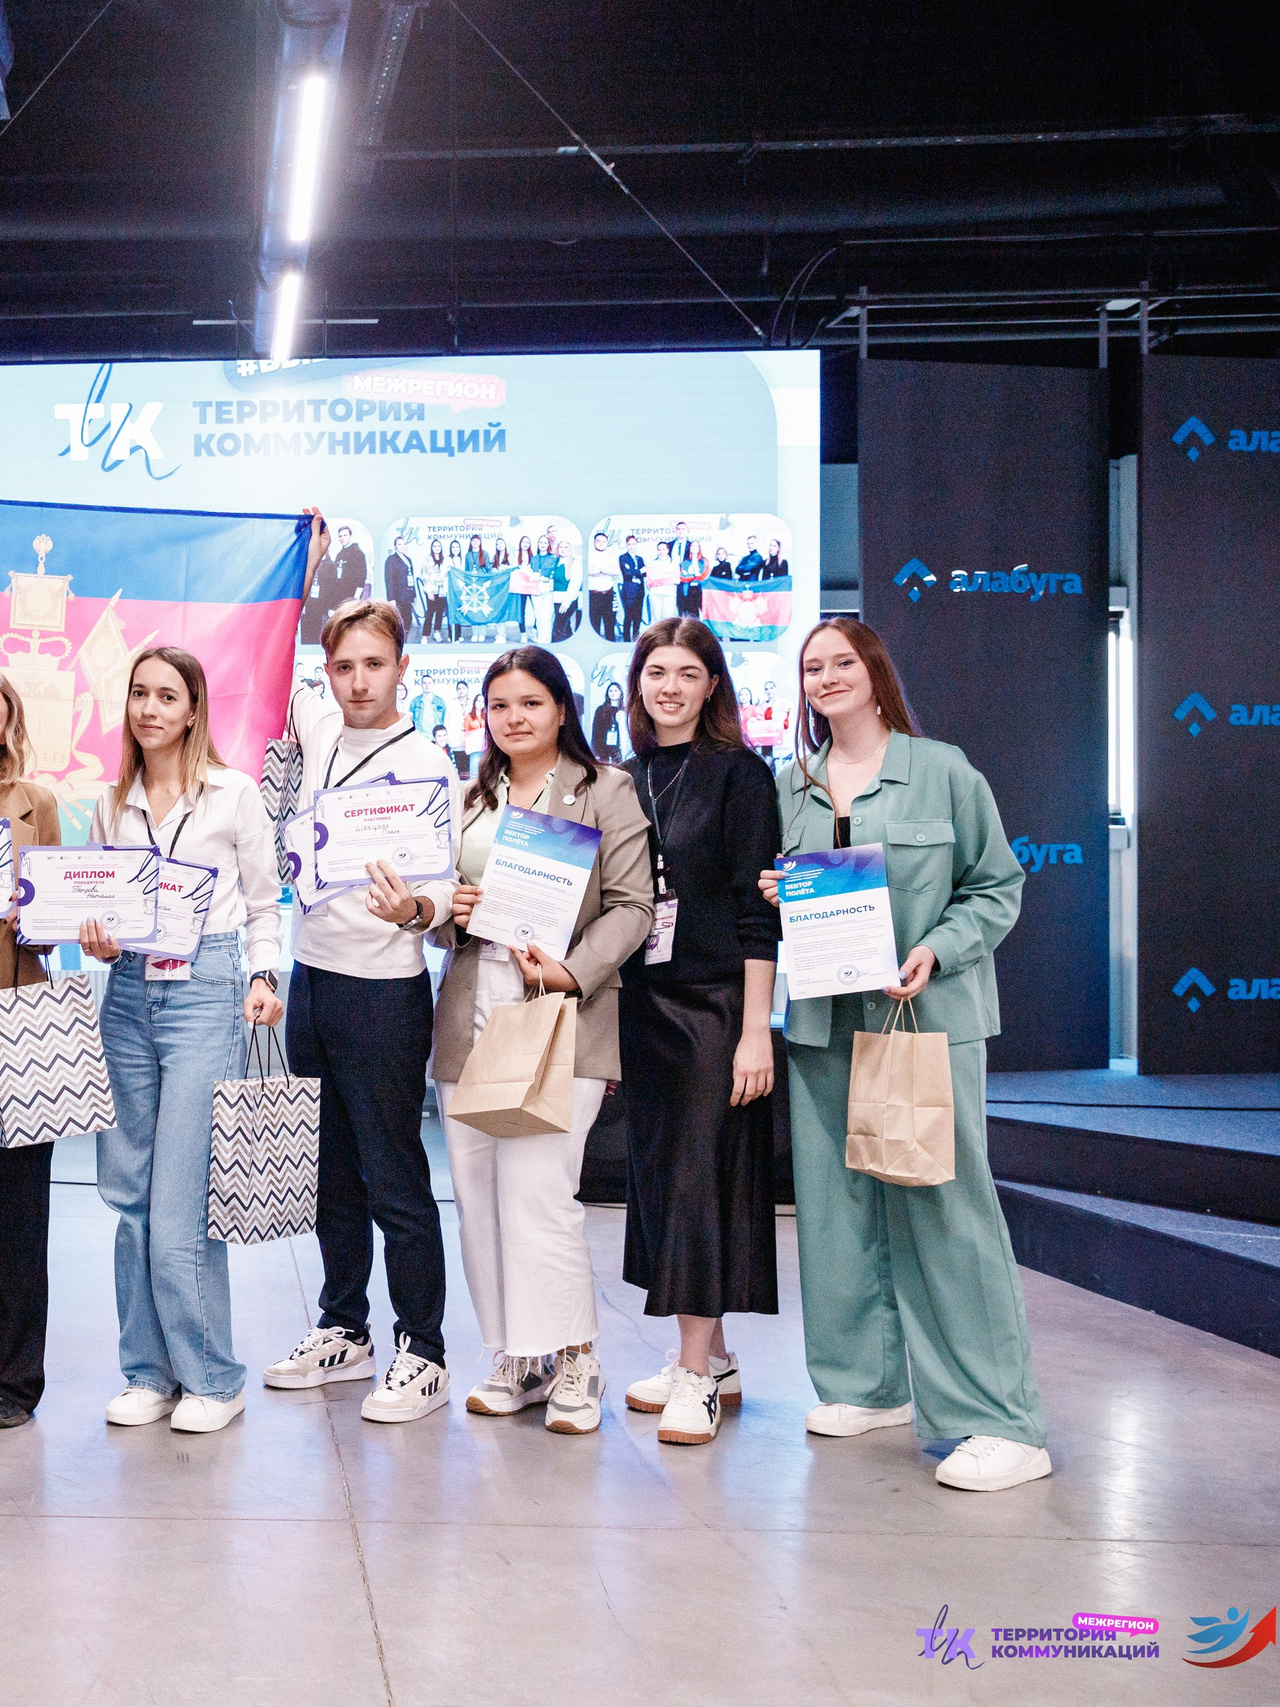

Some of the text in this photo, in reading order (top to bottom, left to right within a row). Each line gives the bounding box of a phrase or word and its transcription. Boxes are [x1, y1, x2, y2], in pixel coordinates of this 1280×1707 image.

[353, 375, 497, 399] МЕЖРЕГИОН
[193, 398, 425, 424] ТЕРРИТОРИЯ
[193, 422, 506, 457] КОММУНИКАЦИЙ
[427, 525, 483, 533] ТЕРРИТОРИЯ
[949, 564, 1083, 602] алабуга
[344, 804, 415, 818] СЕРТИФИКАТ
[502, 835, 529, 847] ПОЛЁТА
[504, 829, 530, 839] ВЕКТОР
[63, 870, 115, 880] ДИПЛОМ
[495, 858, 573, 887] БЛАГОДАРНОСТЬ
[785, 881, 813, 890] ВЕКТОР
[785, 887, 815, 897] ПОЛЁТА
[789, 905, 875, 923] БЛАГОДАРНОСТЬ
